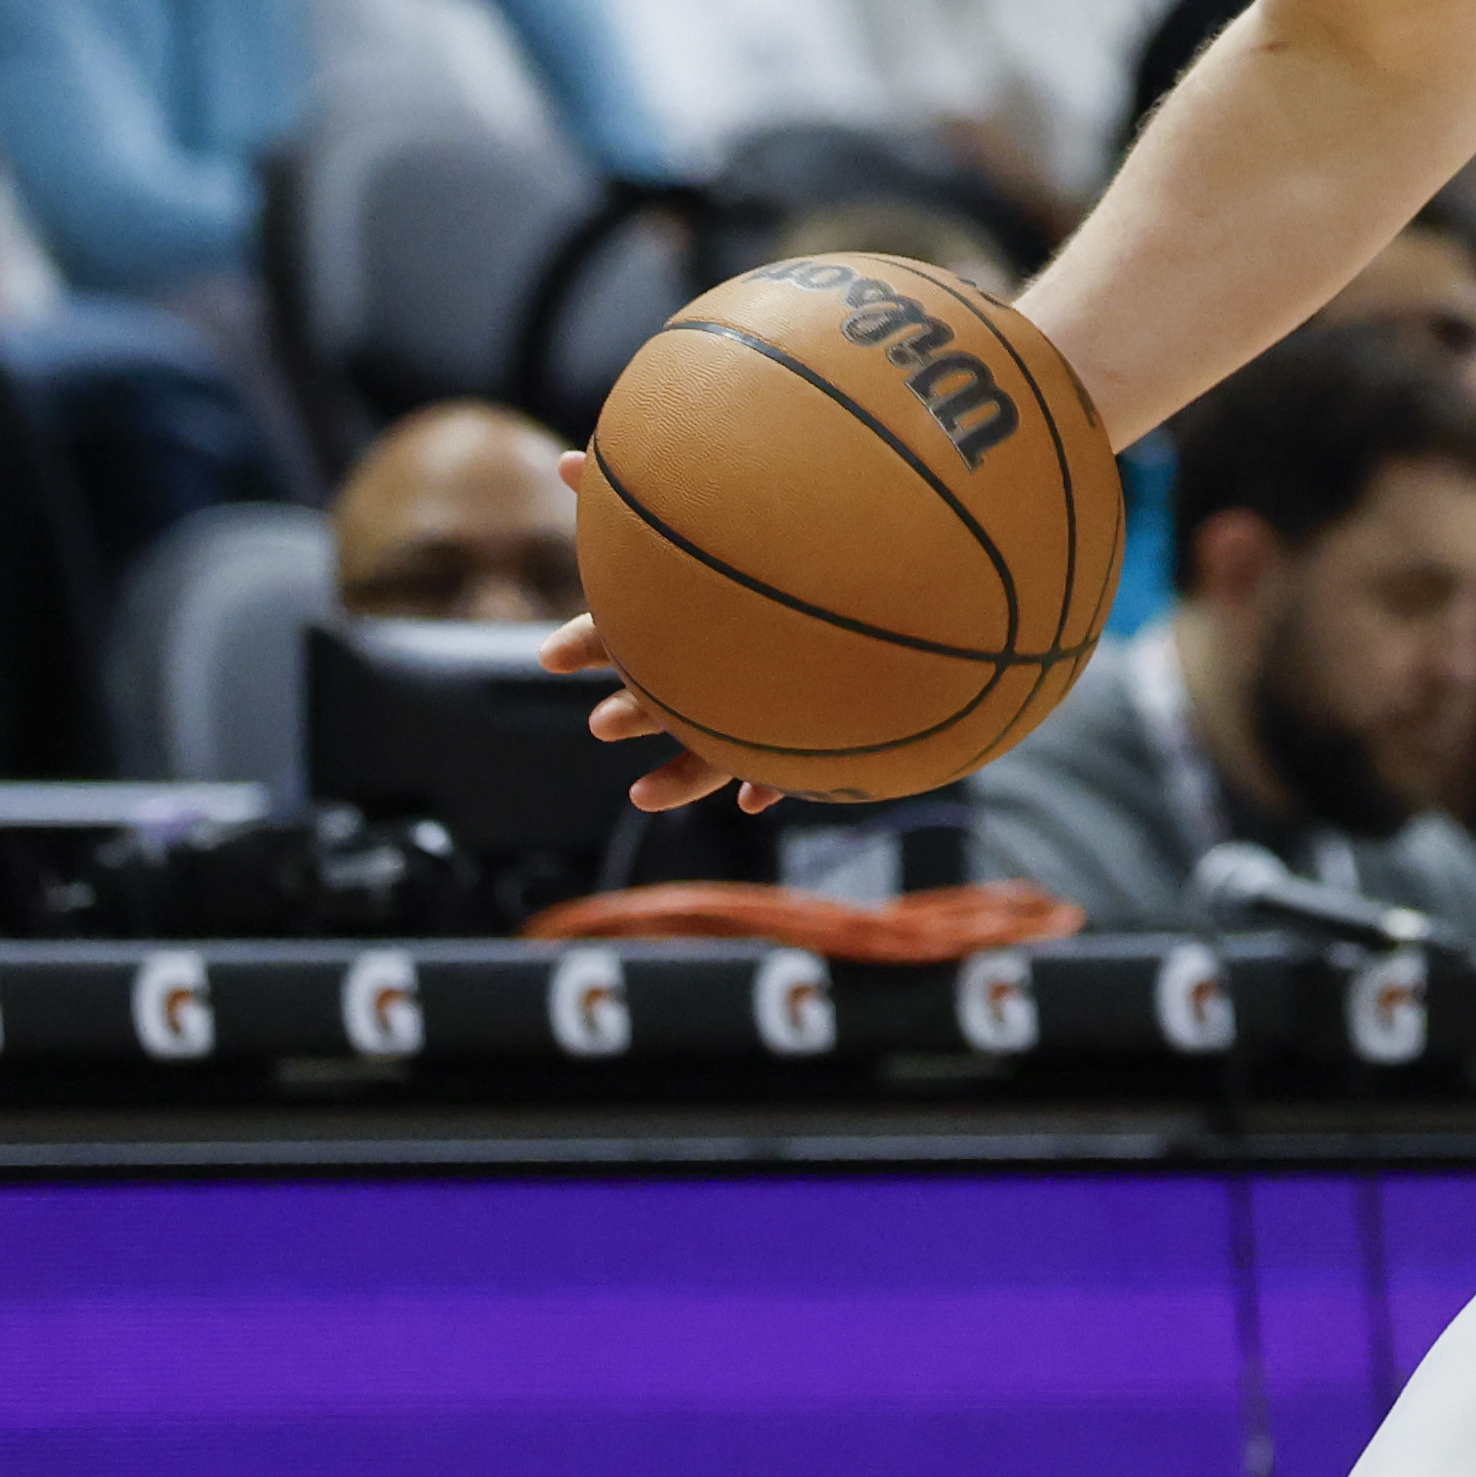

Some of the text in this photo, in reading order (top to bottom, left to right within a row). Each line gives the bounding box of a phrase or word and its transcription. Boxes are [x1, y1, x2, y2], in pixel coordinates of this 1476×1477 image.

[132, 948, 217, 1061] G
[341, 947, 427, 1060] G
[548, 946, 633, 1059] G
[752, 947, 838, 1057] G
[955, 950, 1041, 1056] G
[1154, 946, 1238, 1057] G
